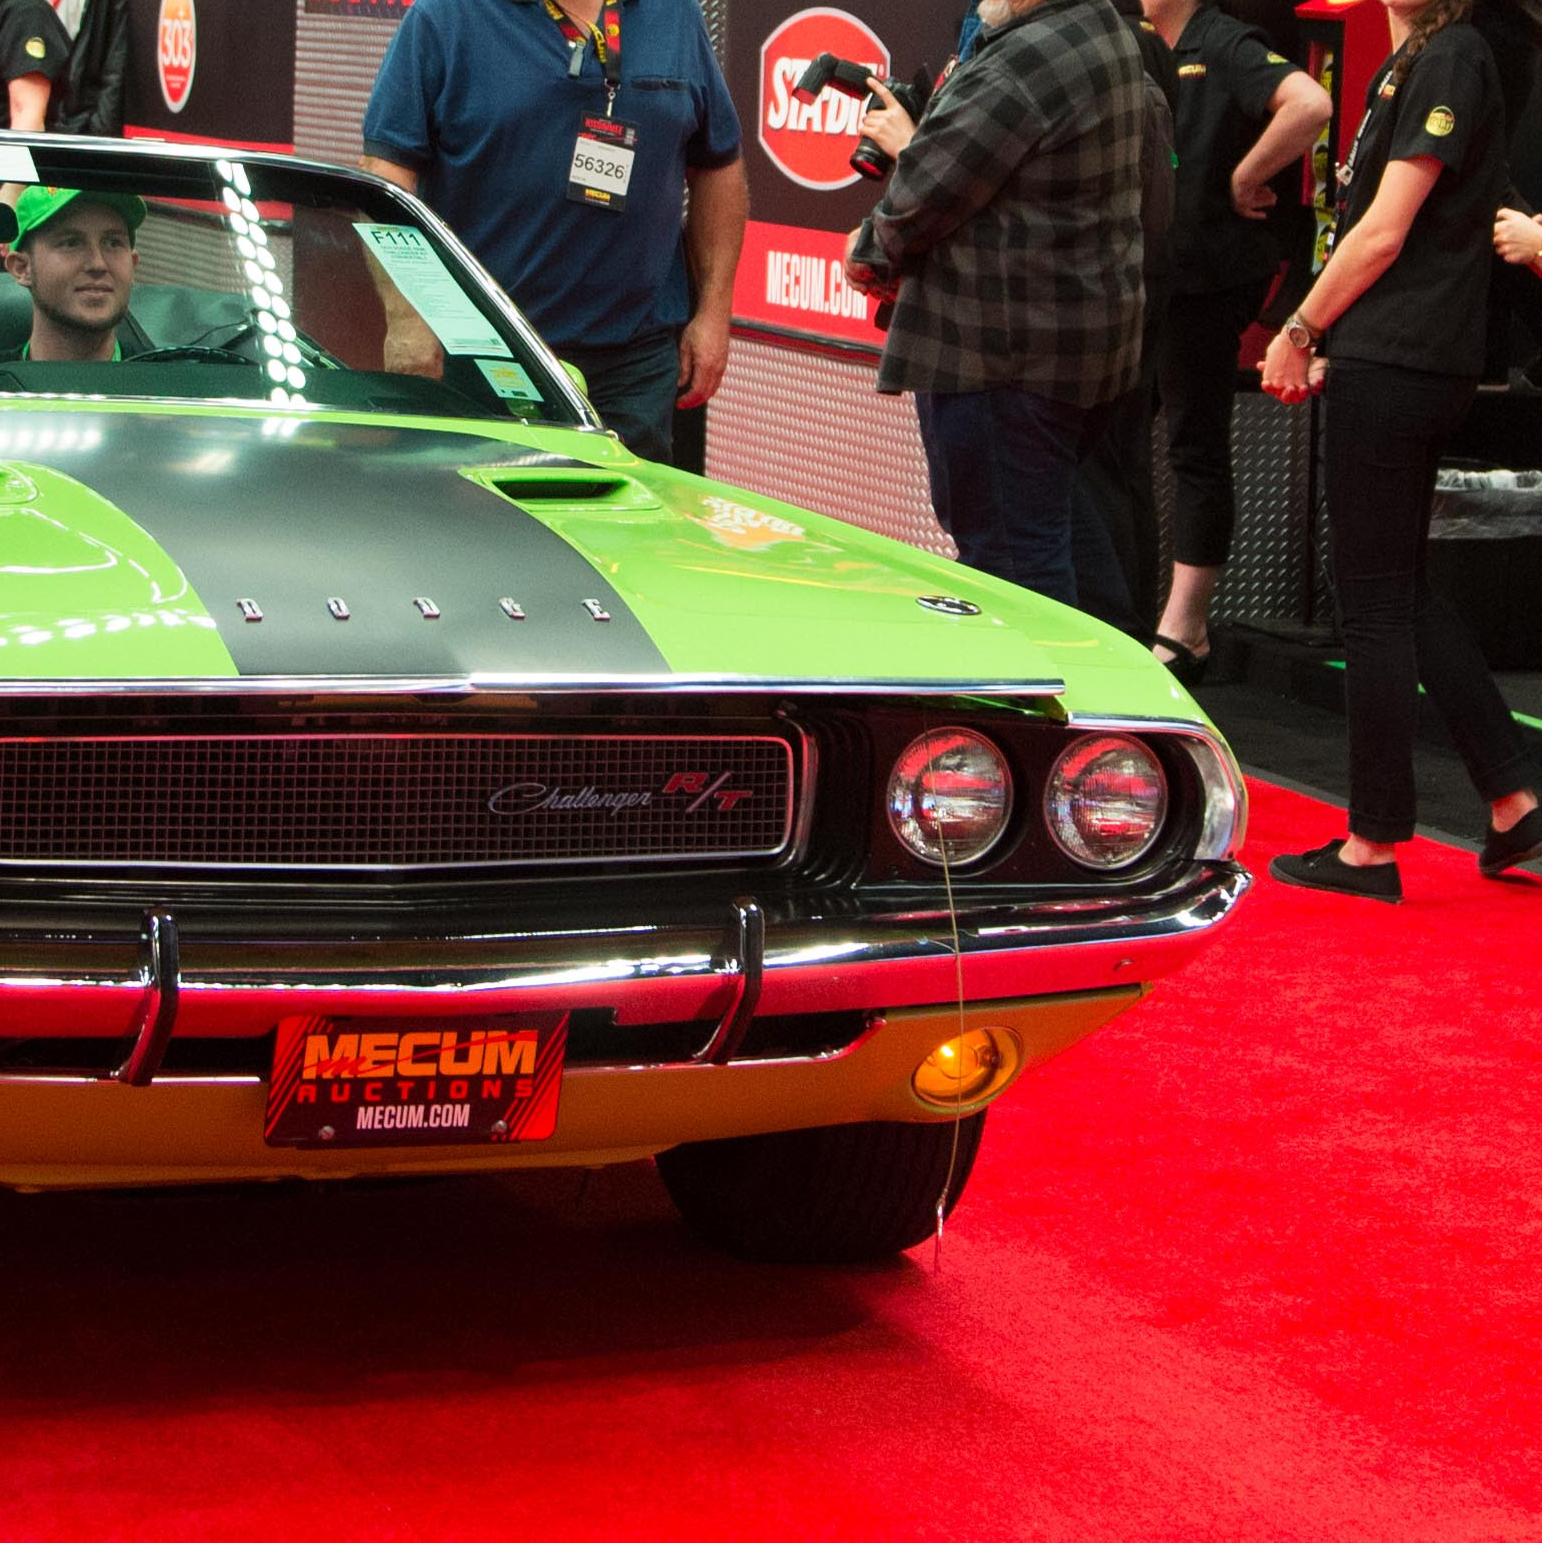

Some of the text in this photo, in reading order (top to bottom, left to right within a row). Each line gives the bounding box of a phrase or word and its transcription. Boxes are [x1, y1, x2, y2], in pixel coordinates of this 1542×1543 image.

[162, 18, 192, 69] 303
[574, 153, 625, 179] 56326
[371, 230, 421, 246] F111
[237, 597, 610, 621] DODGE
[488, 771, 754, 817] Challenger R/T
[302, 1030, 538, 1080] MECUM
[297, 1079, 535, 1104] AUCTIONS
[357, 1104, 470, 1130] MECUM.COM
